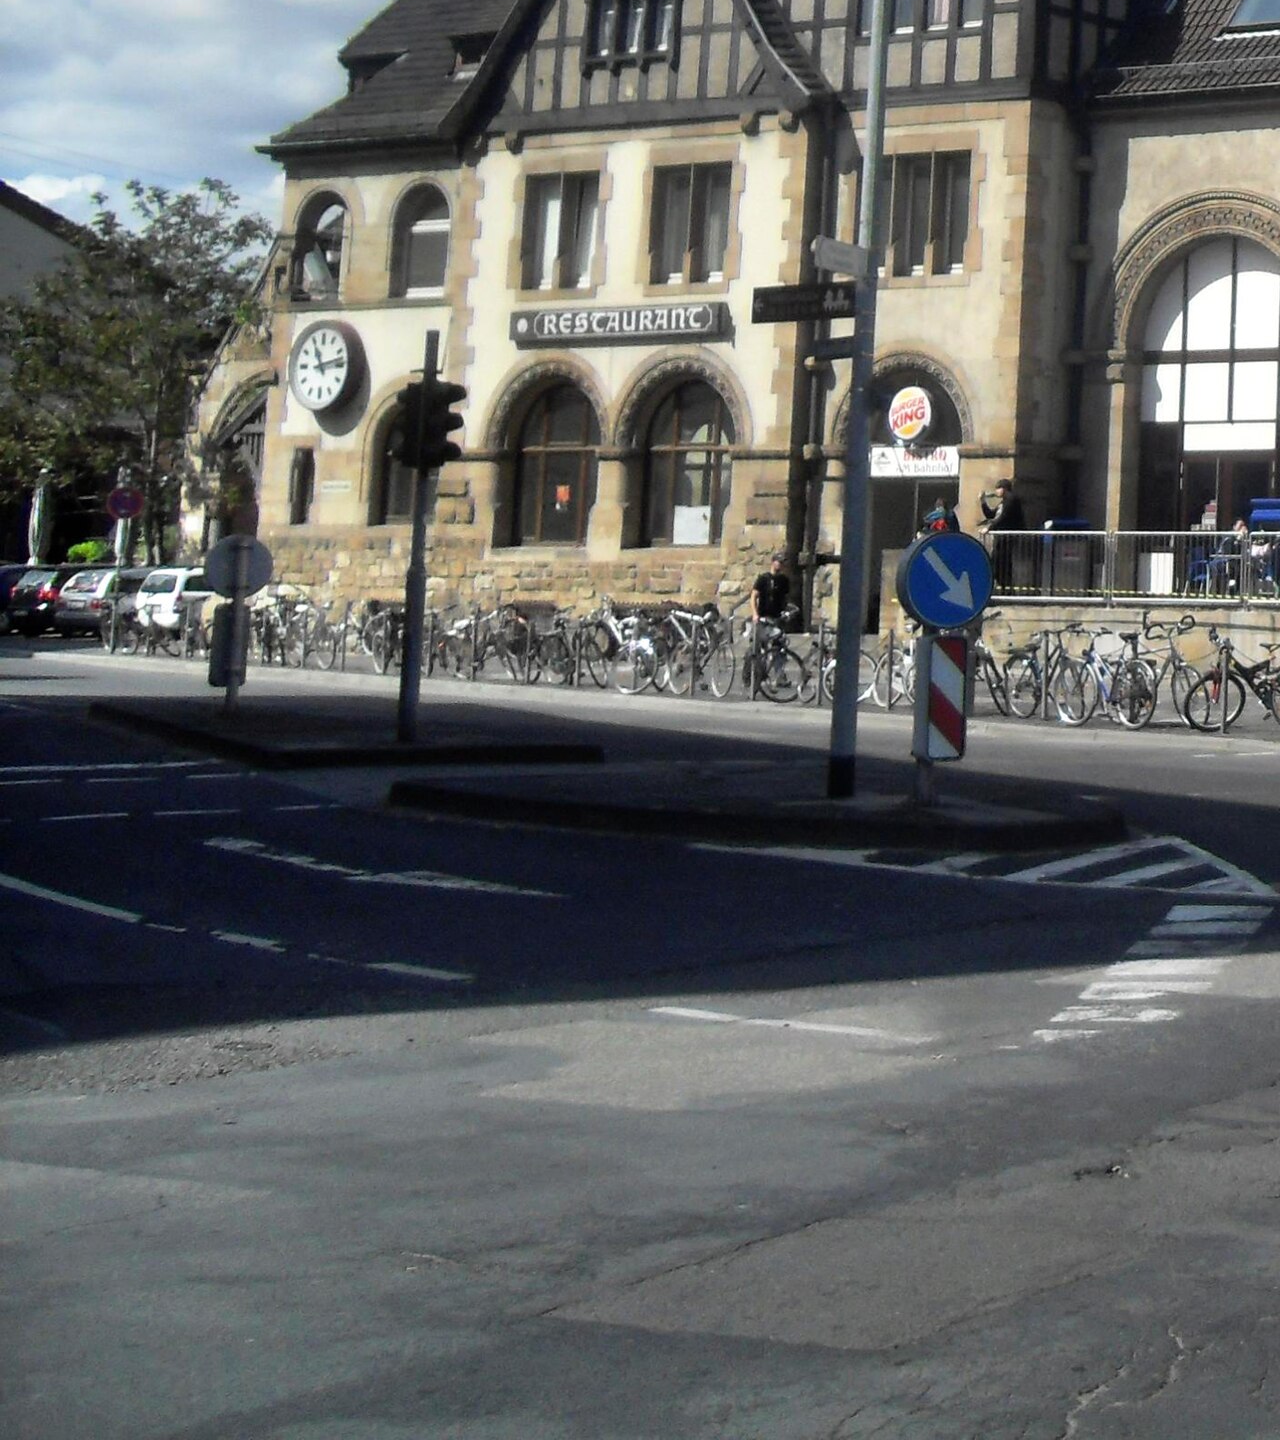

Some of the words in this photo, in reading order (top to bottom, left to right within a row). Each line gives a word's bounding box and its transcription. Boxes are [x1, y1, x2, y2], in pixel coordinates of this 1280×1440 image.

[542, 306, 704, 335] RESTAURANT
[891, 396, 926, 417] BURGER
[891, 406, 926, 431] KING
[914, 462, 953, 473] Bahnhof
